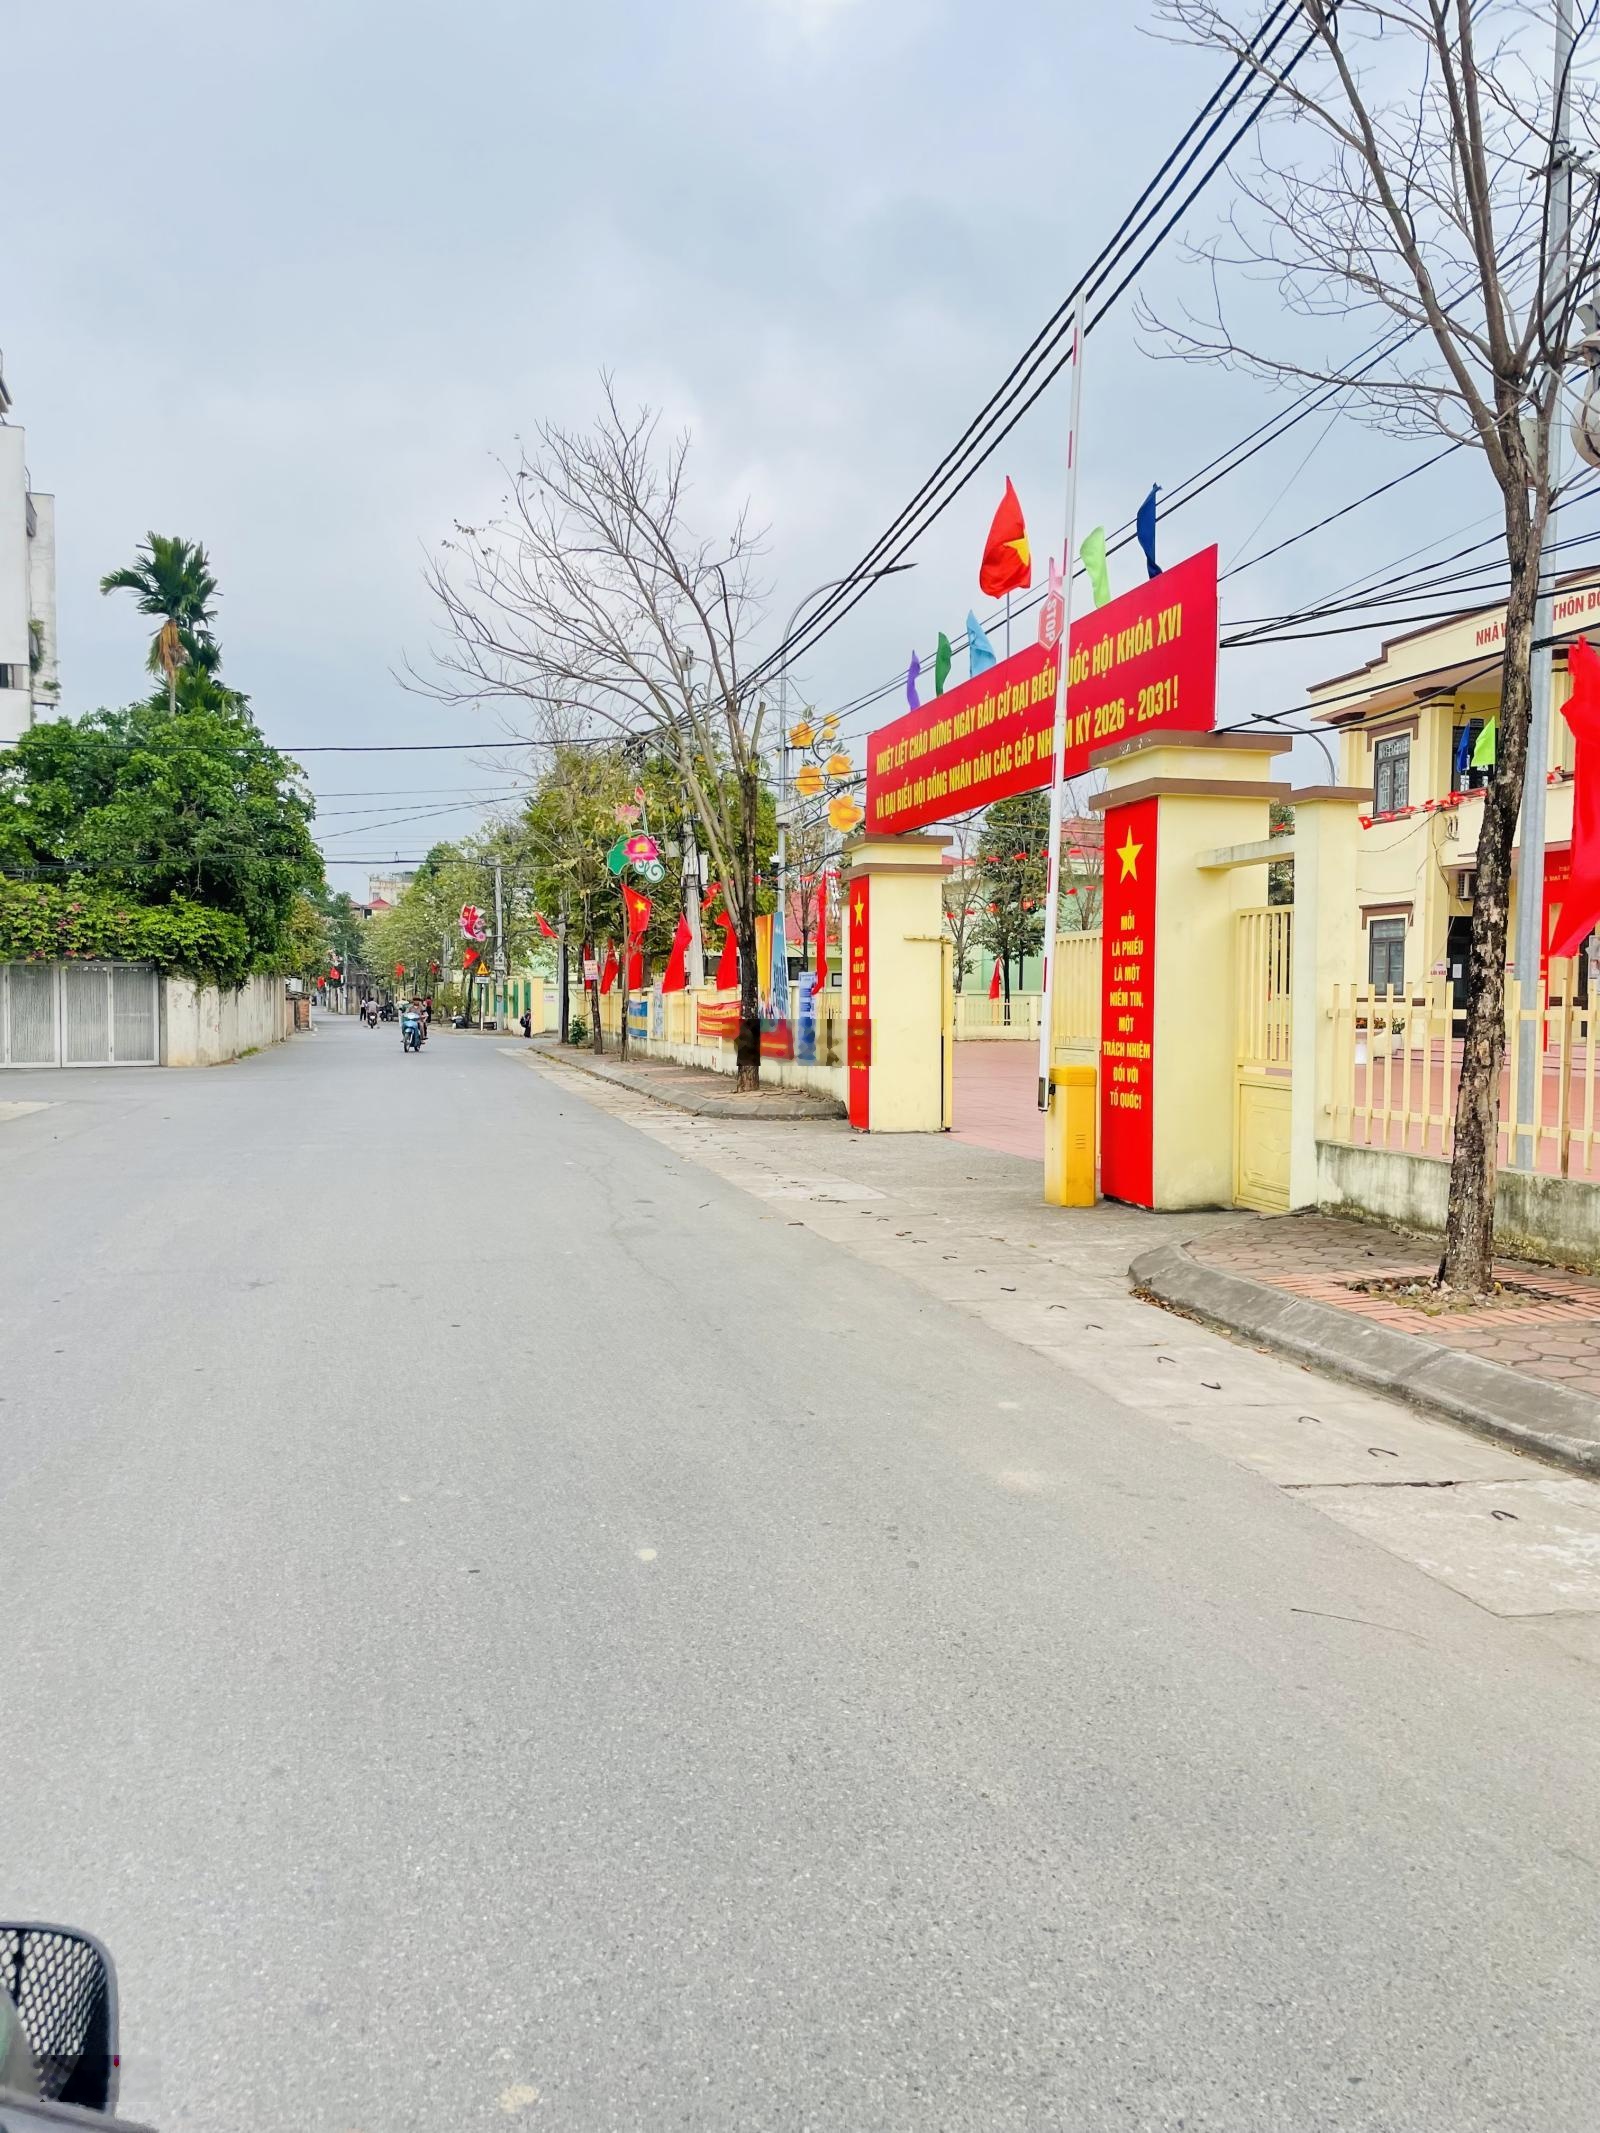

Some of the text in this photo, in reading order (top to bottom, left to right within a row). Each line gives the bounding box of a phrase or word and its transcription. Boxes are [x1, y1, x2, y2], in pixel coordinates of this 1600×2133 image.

[1045, 598, 1057, 642] STOP
[1475, 621, 1499, 646] NHÀ
[1553, 595, 1584, 621] THÔN
[876, 602, 1182, 777] NHIỆT LIỆT CHÀO MỪNG NGÀY BẦU CỬ ĐẠI BIỂU UỐC HỘI KHÓA XVI
[876, 791, 885, 820] VÀ
[885, 789, 897, 820] ĐẠI
[897, 776, 913, 812] BIỂU
[913, 775, 926, 809] HỘI
[927, 766, 948, 800] ĐỒNG
[949, 758, 972, 793] NHÂN
[973, 749, 992, 782] DÂN
[993, 740, 1012, 776] CÁC
[1014, 726, 1035, 769] CẤP
[1075, 705, 1091, 745] KỲ
[1093, 697, 1125, 739] 2026
[1137, 674, 1179, 722] 2031!
[1121, 935, 1144, 956] PHIẾU
[1124, 962, 1140, 984] MỘT
[1129, 991, 1144, 1008] TIN,
[1118, 1013, 1134, 1035] MỘT
[1103, 1038, 1151, 1062] TRÁCH NHIỆM
[1113, 1061, 1139, 1084] ĐỐI VỚI
[1110, 1086, 1142, 1110] TỔ QUỐC!
